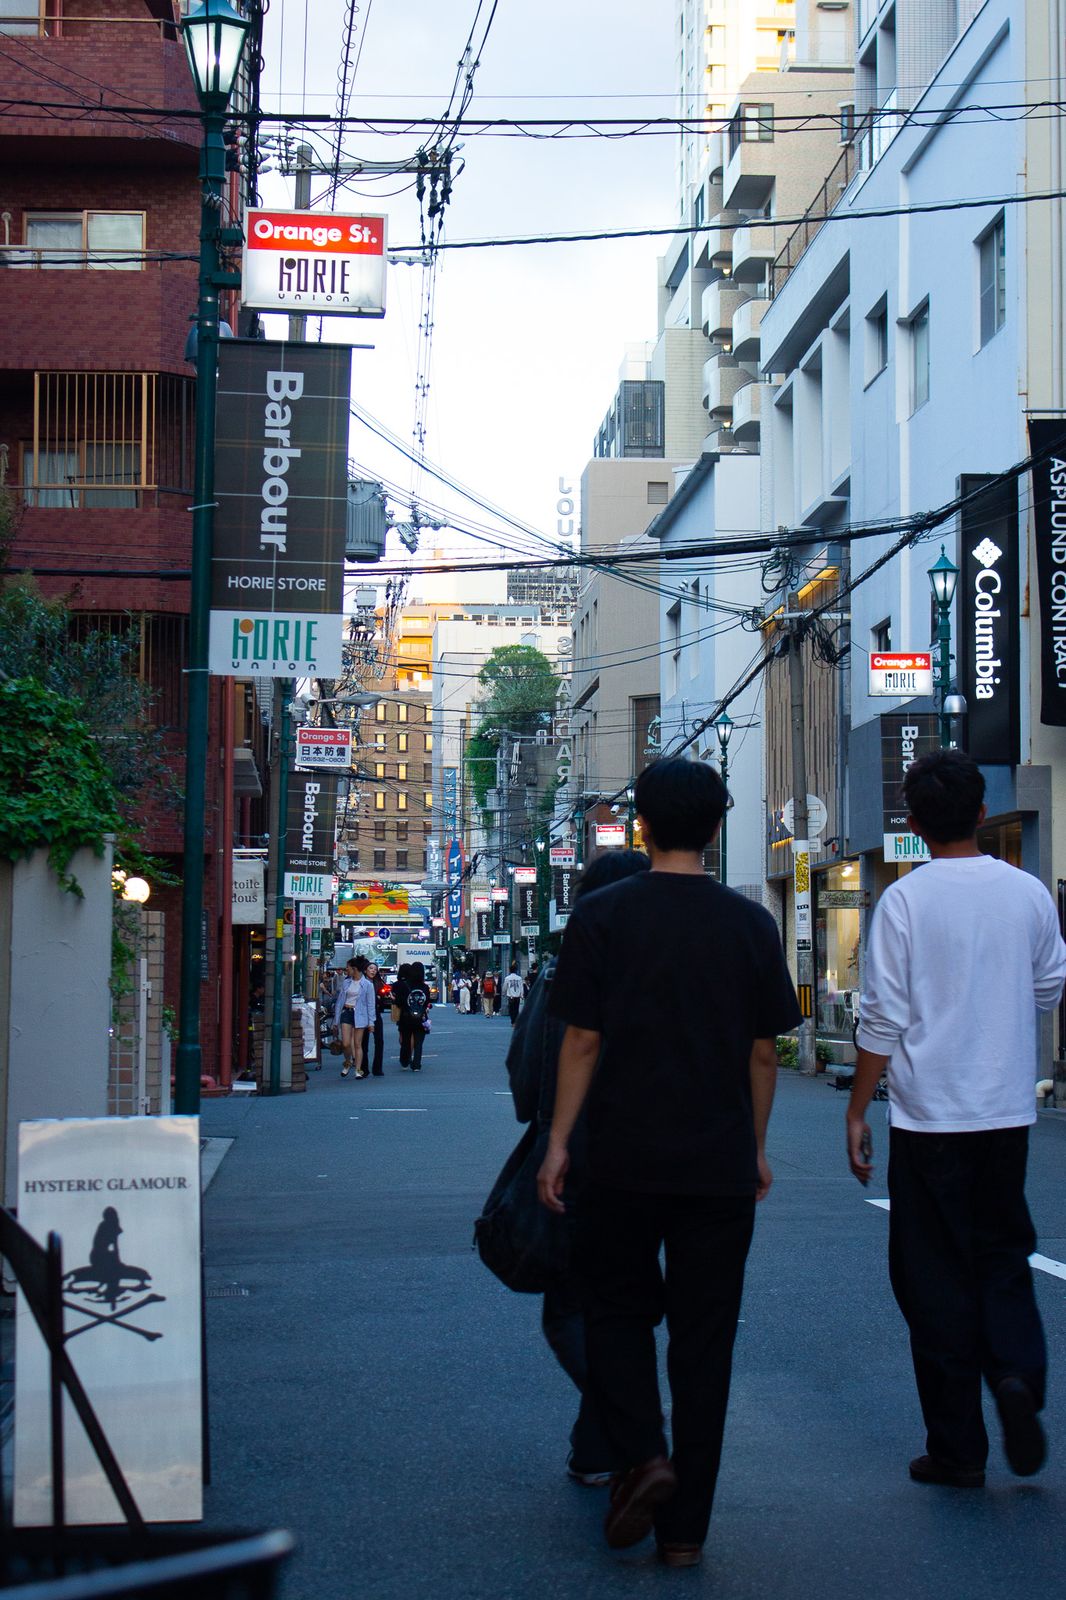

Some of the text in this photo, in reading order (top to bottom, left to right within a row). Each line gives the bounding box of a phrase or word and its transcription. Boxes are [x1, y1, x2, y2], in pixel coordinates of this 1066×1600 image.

[254, 219, 378, 246] Orange St.
[278, 293, 350, 302] union
[260, 371, 304, 553] Barbour
[228, 576, 326, 590] HORIE STORE
[974, 569, 1001, 700] Columbia
[231, 661, 317, 671] union
[873, 657, 928, 669] Orange St.
[301, 732, 348, 742] Orange St.
[302, 782, 321, 852] Barbour
[232, 879, 260, 889] toile
[24, 1177, 188, 1193] HYSTERIC GLAMOUR
